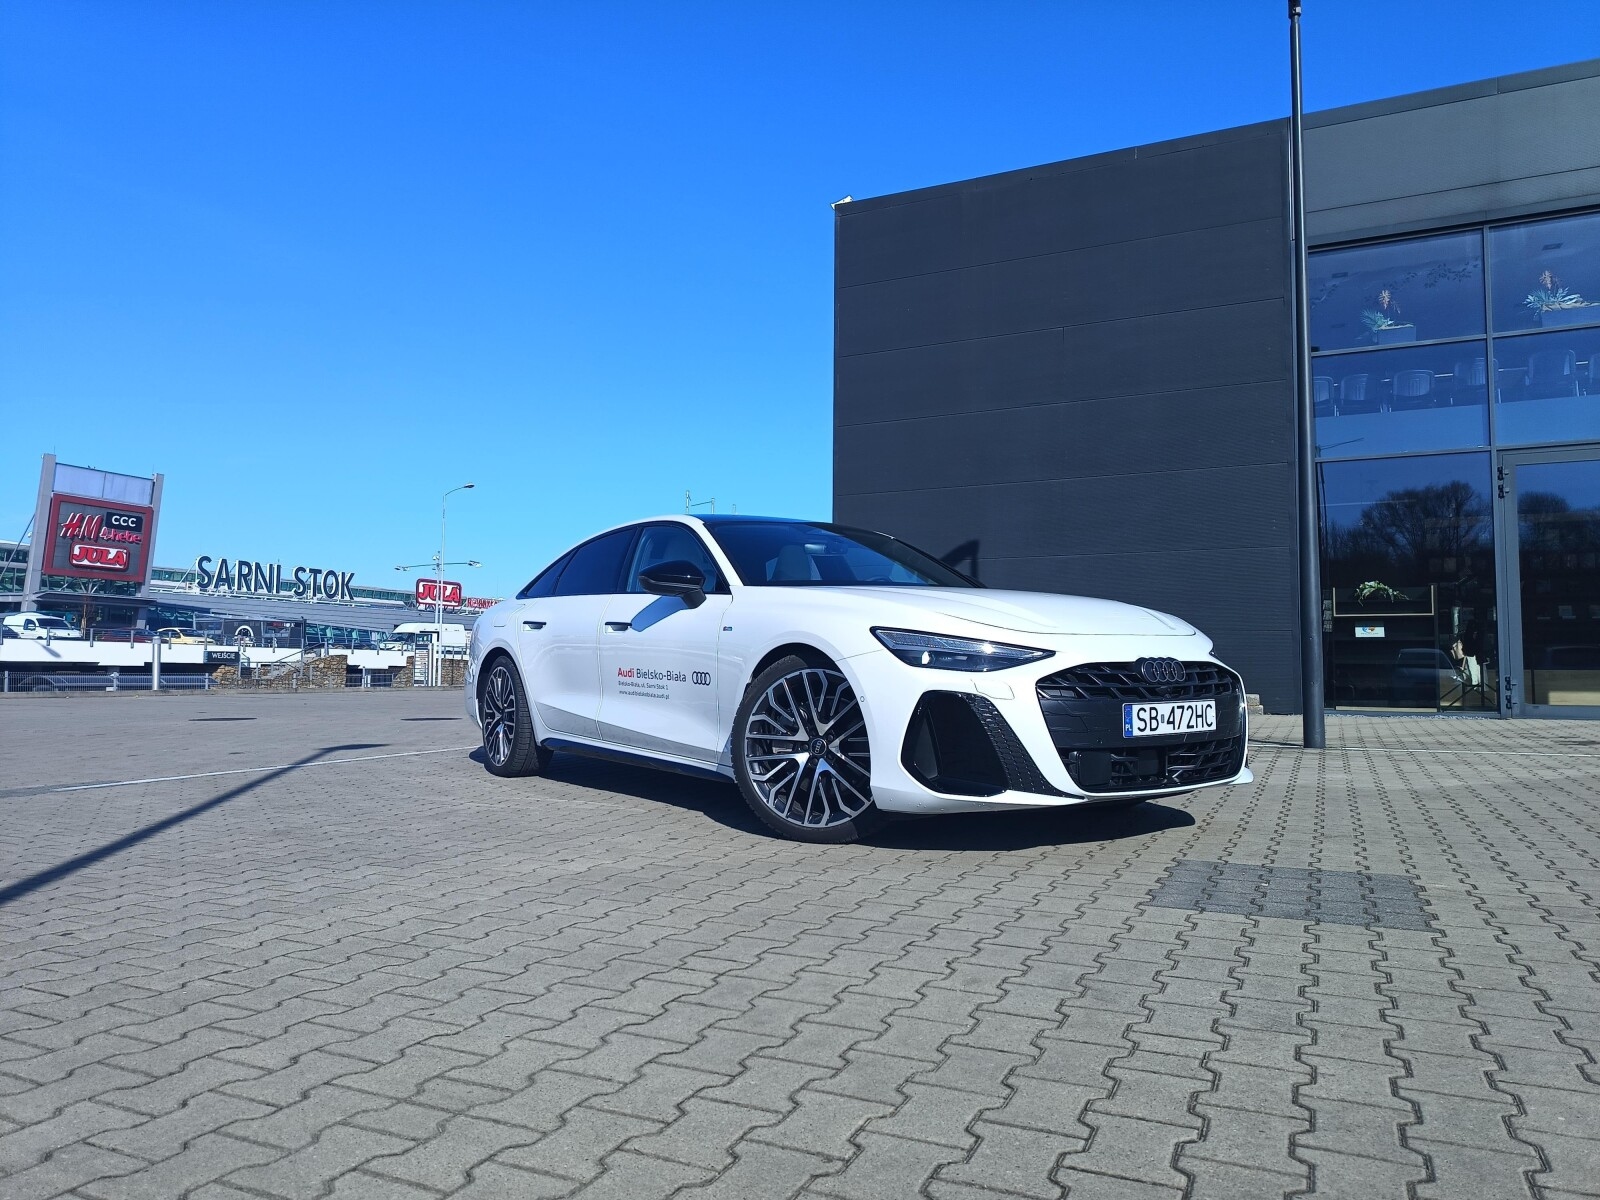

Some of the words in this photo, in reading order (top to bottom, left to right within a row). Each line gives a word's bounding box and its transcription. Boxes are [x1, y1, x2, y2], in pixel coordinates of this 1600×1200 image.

[60, 512, 102, 540] H&M
[111, 515, 137, 527] CCC
[72, 546, 126, 566] JULA
[197, 555, 282, 594] SARNI
[292, 566, 355, 601] STOK
[617, 667, 635, 678] Audi
[636, 668, 687, 682] Bielsko-Biała
[1136, 706, 1160, 732] SB
[1166, 704, 1213, 730] 472HC
